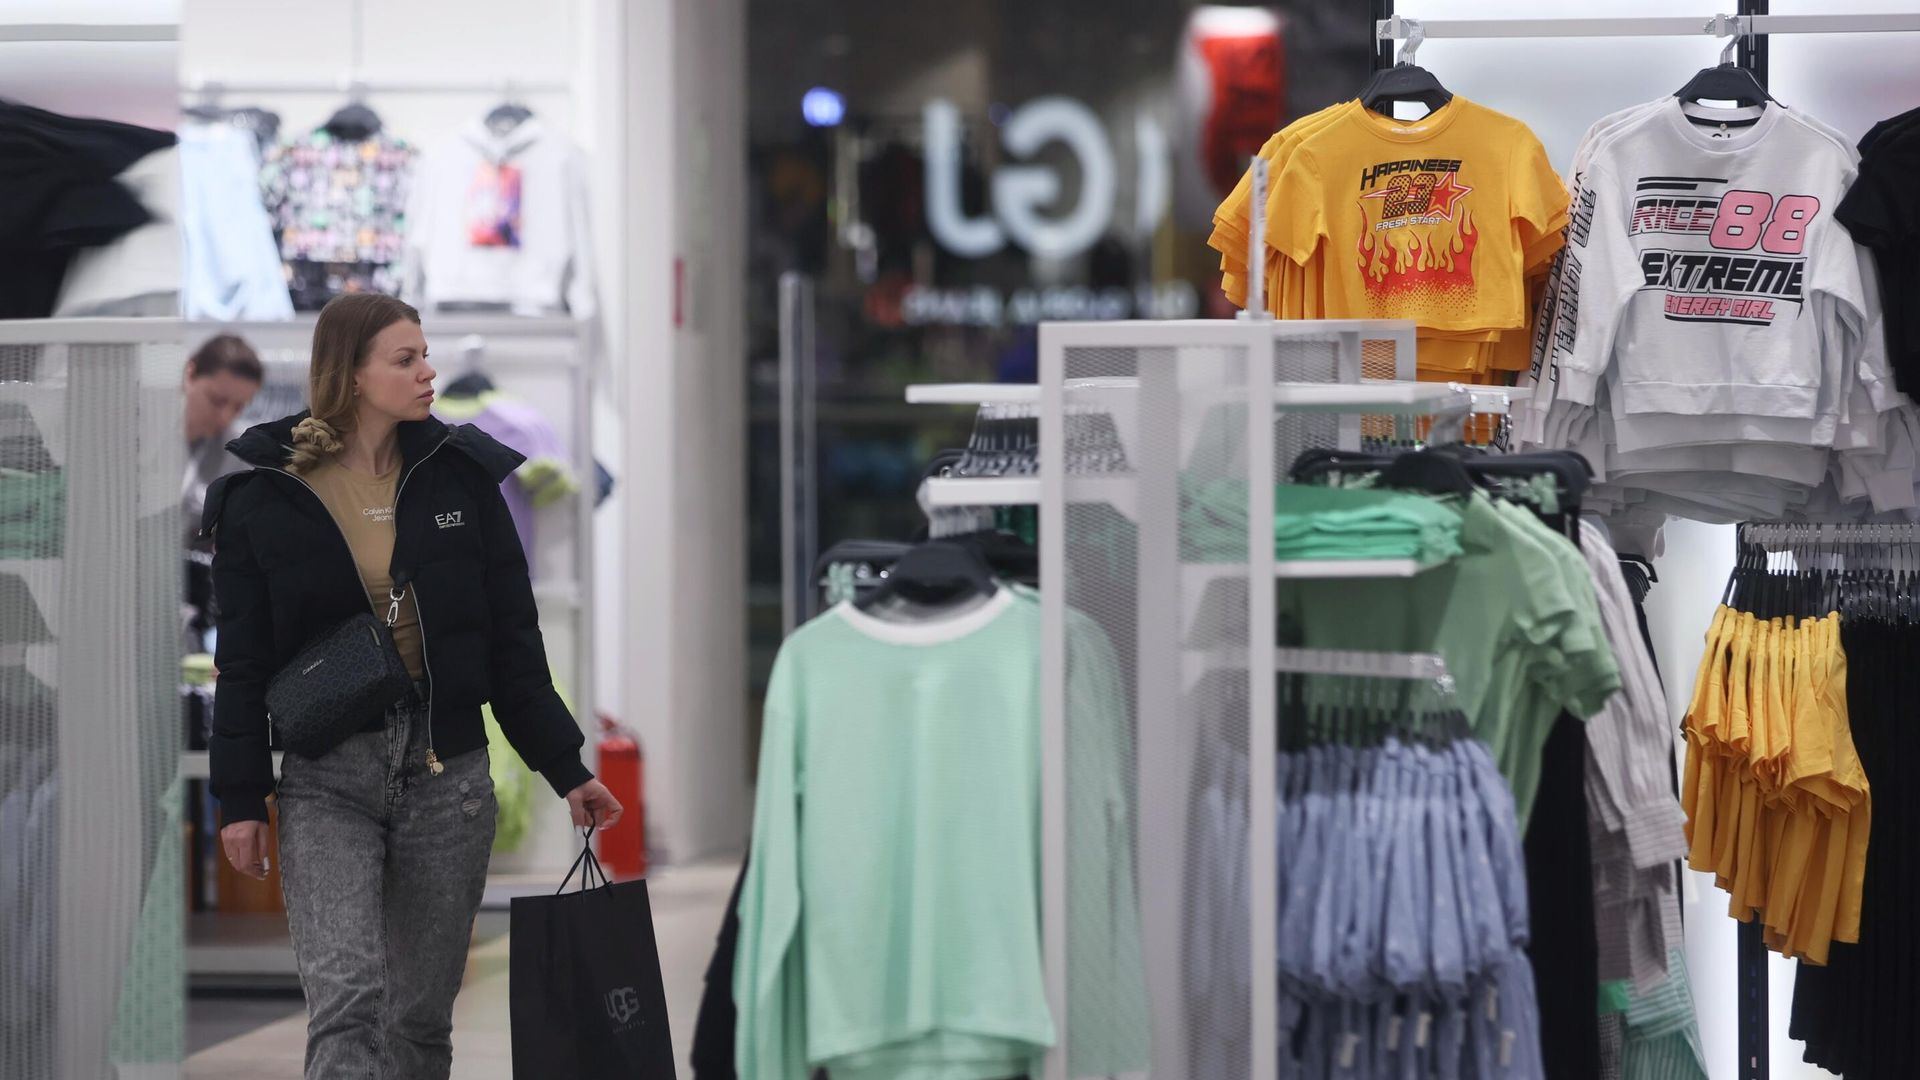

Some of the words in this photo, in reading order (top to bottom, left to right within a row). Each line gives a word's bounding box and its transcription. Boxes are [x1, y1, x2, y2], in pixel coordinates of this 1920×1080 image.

[1360, 159, 1462, 191] HAPPINESS
[1382, 173, 1438, 219] 23
[1375, 219, 1408, 232] FRESH
[1410, 216, 1442, 226] START
[1630, 197, 1721, 234] RACE
[1708, 189, 1821, 255] 88
[1640, 252, 1804, 296] EXTREME
[1664, 294, 1732, 316] ENERGY
[1730, 301, 1776, 320] GIRL
[434, 510, 462, 526] EA7
[603, 986, 641, 1023] UGG
